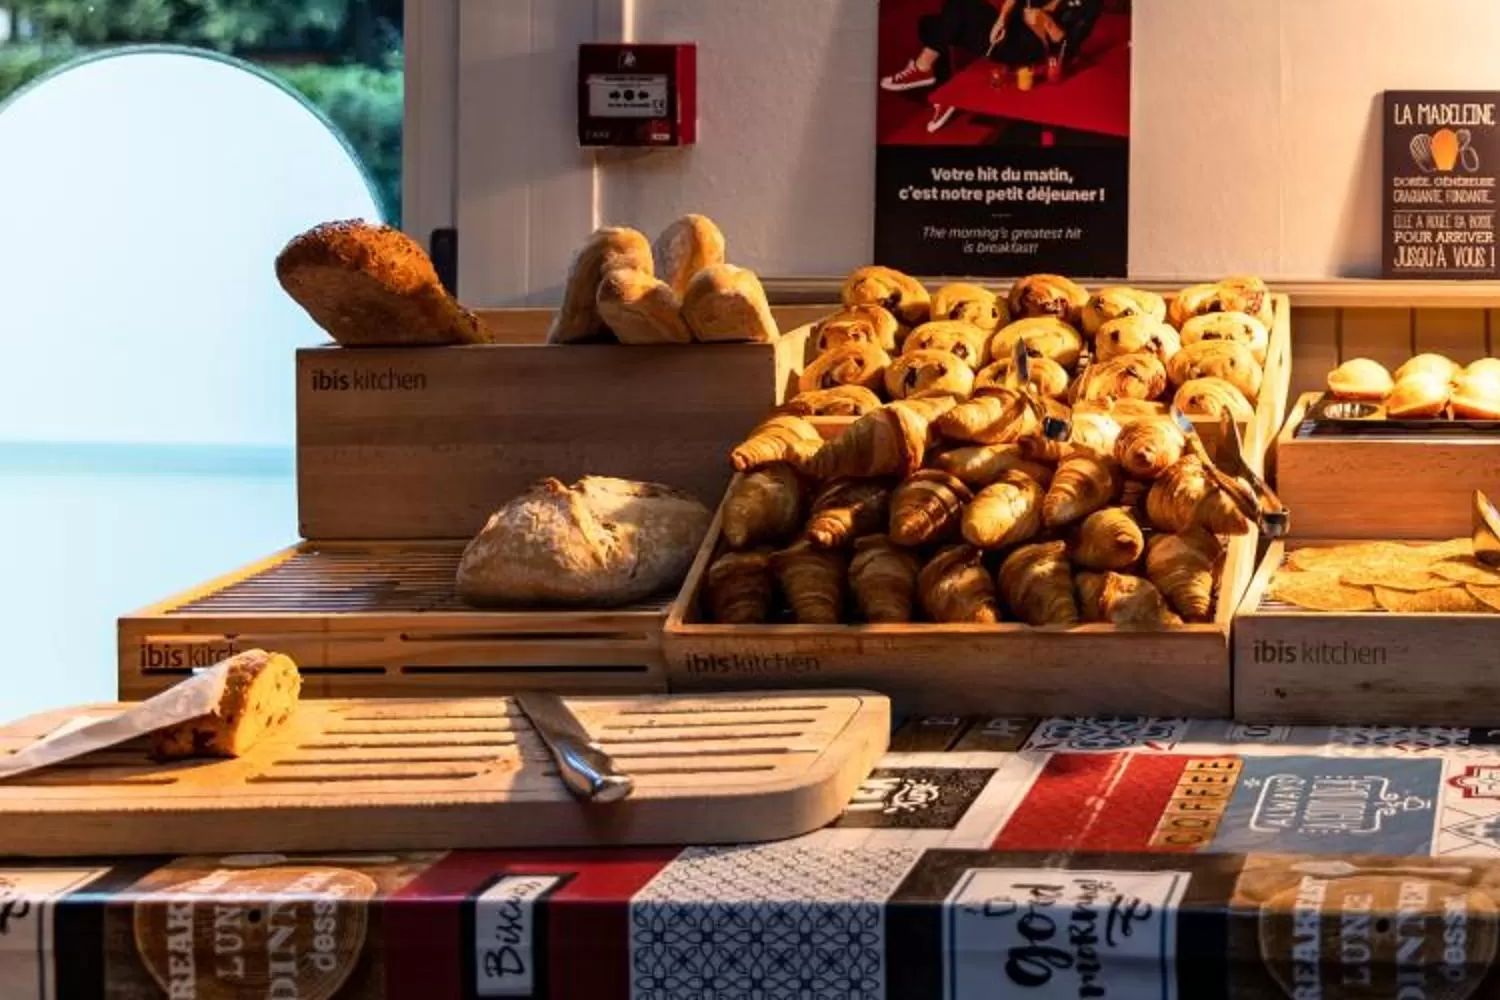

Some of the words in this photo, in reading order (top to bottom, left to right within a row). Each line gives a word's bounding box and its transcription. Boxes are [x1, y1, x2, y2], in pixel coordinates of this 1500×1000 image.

[1394, 103, 1413, 125] LA
[930, 166, 975, 182] Votre
[977, 165, 999, 182] hit
[1000, 165, 1021, 182] du
[1023, 166, 1075, 185] matin,
[898, 185, 938, 202] c'est
[940, 187, 984, 202] notre
[985, 185, 1024, 206] petit
[1025, 185, 1097, 206] déjeuner
[922, 225, 946, 240] The
[947, 226, 1009, 243] morning's
[1010, 227, 1063, 243] greatest
[1064, 226, 1083, 240] hit
[1394, 231, 1432, 244] POUR
[1435, 231, 1495, 244] ARRIVER
[963, 242, 974, 254] is
[1453, 245, 1487, 268] VOUS
[311, 368, 350, 392] ibis
[353, 367, 428, 391] kitchen
[140, 643, 184, 668] ibis
[684, 652, 730, 673] ibis
[1252, 639, 1297, 665] ibis
[1301, 639, 1388, 665] kitchen
[1163, 761, 1237, 845] COFFEE
